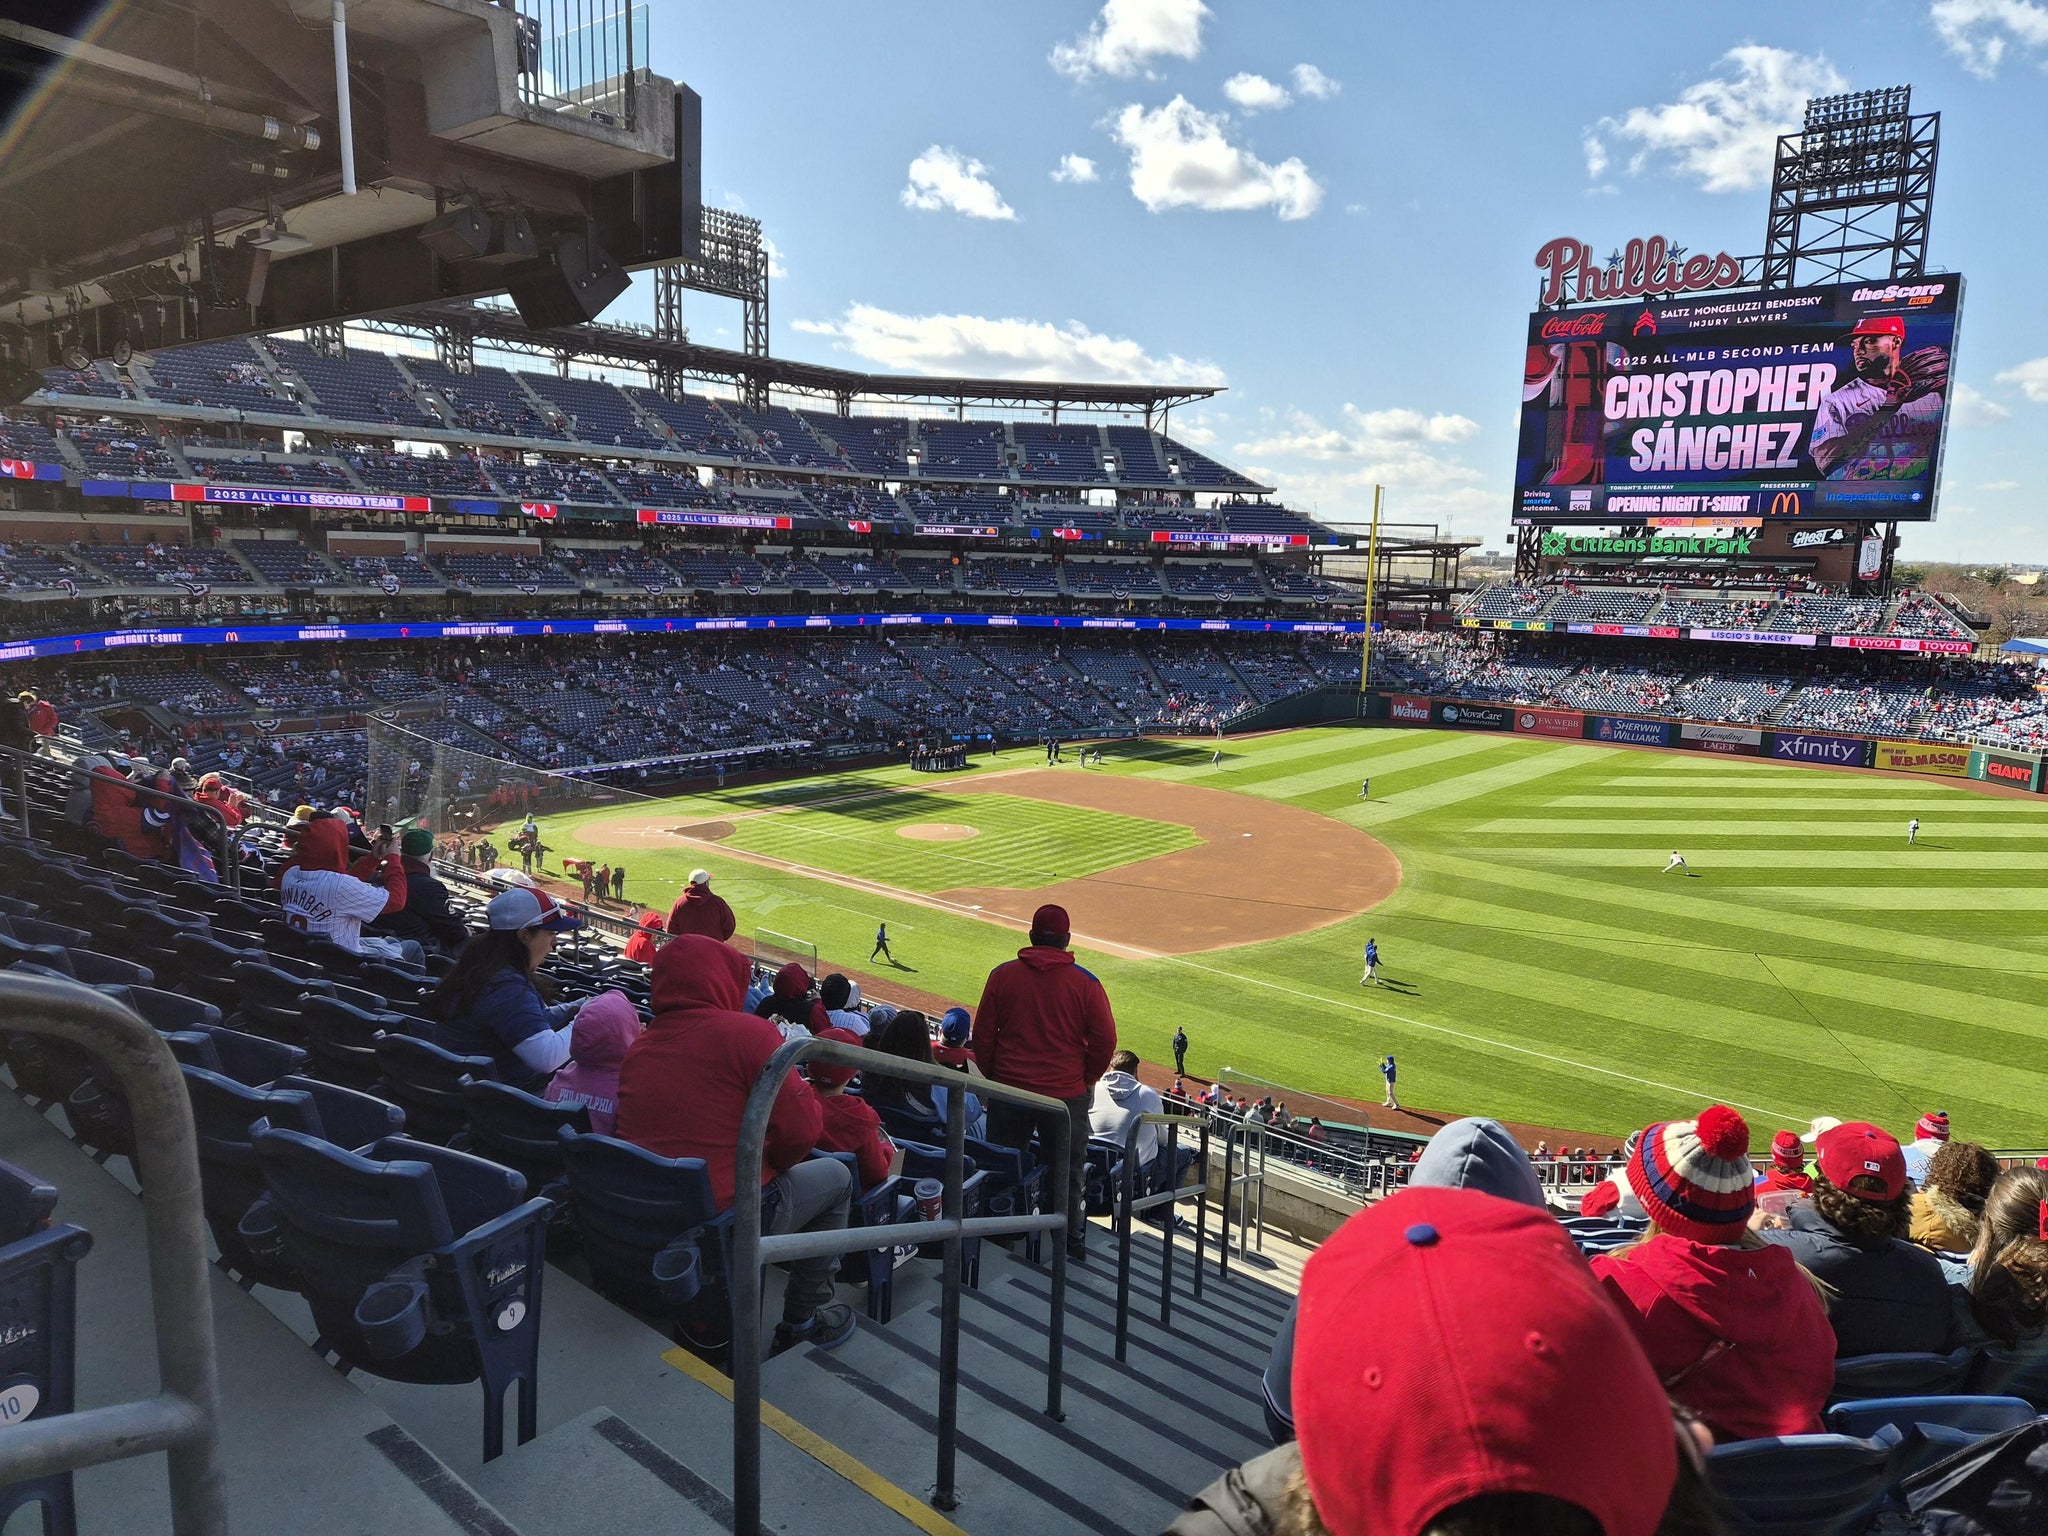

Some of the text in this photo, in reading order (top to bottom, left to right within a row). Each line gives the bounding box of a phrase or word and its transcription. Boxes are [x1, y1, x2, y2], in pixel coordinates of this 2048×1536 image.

[1535, 235, 1742, 306] Phillies
[1851, 284, 1945, 302] theScore
[1661, 296, 1822, 319] SALTZ MONGELUZZI BENDESKY
[1542, 313, 1609, 339] Coca-Cola
[1689, 313, 1788, 328] INJURY LAWYERS
[1614, 342, 1835, 367] 2025 ALL-MLB SECOND TEAM
[1604, 362, 1838, 420] CRISTOPHER
[1629, 420, 1803, 472] SÁNCHEZ
[214, 490, 398, 508] 2025 ALL-MLB SECOND TEAM
[1524, 490, 1551, 498] Driving
[1826, 491, 1907, 504] Independence
[1607, 495, 1750, 512] OPENING NIGHT T-SHIRT
[661, 513, 772, 526] 2025 ALL-MLB SECOND TEAM
[1571, 535, 1751, 554] Citizens Bank Park
[1792, 528, 1835, 547] GHOST
[1461, 619, 1480, 628] UKG
[1494, 620, 1512, 629] UKG
[1526, 622, 1545, 631] UKG
[1652, 628, 1677, 637] NECA
[1711, 631, 1793, 643] LISCIO'S BAKERY
[1853, 638, 1897, 648] TOYOTA
[1923, 641, 1969, 652] TOYOTA
[1393, 704, 1428, 719] Wawa
[1459, 708, 1502, 720] NovaCare
[1554, 718, 1579, 727] WEBB
[1615, 720, 1661, 734] SHERWIN
[1696, 727, 1746, 742] Yuengling
[1761, 726, 1802, 734] ASPLUNDH
[1811, 731, 1854, 739] ASPLUNDH
[1863, 735, 1907, 743] ASPLUNDH
[1918, 740, 1965, 748] ASPLUNDH
[1703, 741, 1735, 751] LAGER
[1779, 737, 1856, 761] xfinity
[1988, 762, 2032, 781] GIANT
[560, 1088, 614, 1114] PHILADELPHIA
[510, 1308, 515, 1321] 9
[0, 1397, 20, 1420] 10
